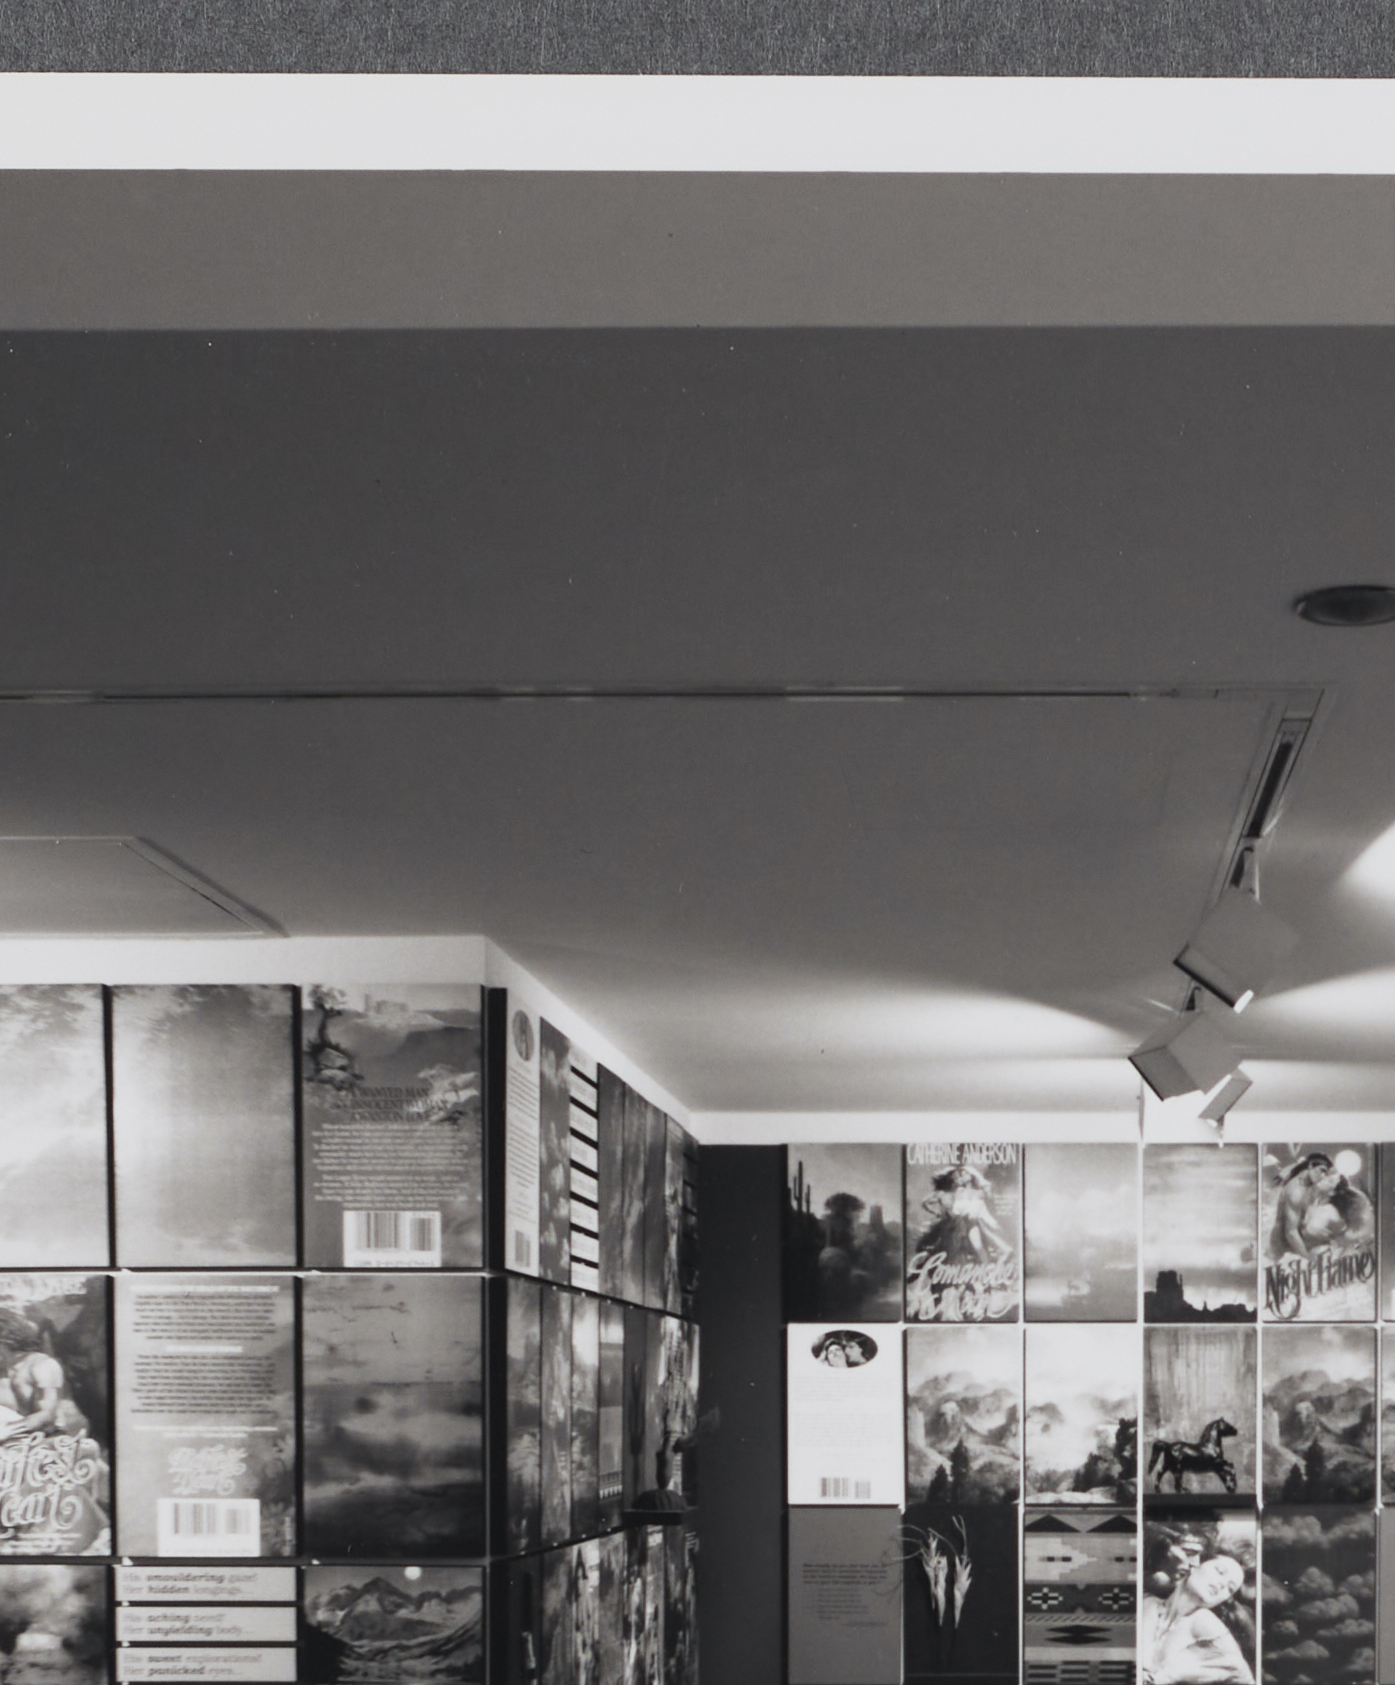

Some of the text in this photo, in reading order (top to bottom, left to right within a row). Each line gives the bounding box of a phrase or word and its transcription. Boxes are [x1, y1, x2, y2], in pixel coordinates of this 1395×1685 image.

[907, 1143, 1017, 1165] CATHERINE ANDERSON
[146, 1573, 226, 1584] smouldering
[147, 1585, 190, 1594] hidden
[147, 1613, 191, 1624] aching
[147, 1626, 214, 1637] unyielding
[147, 1666, 206, 1677] panicked
